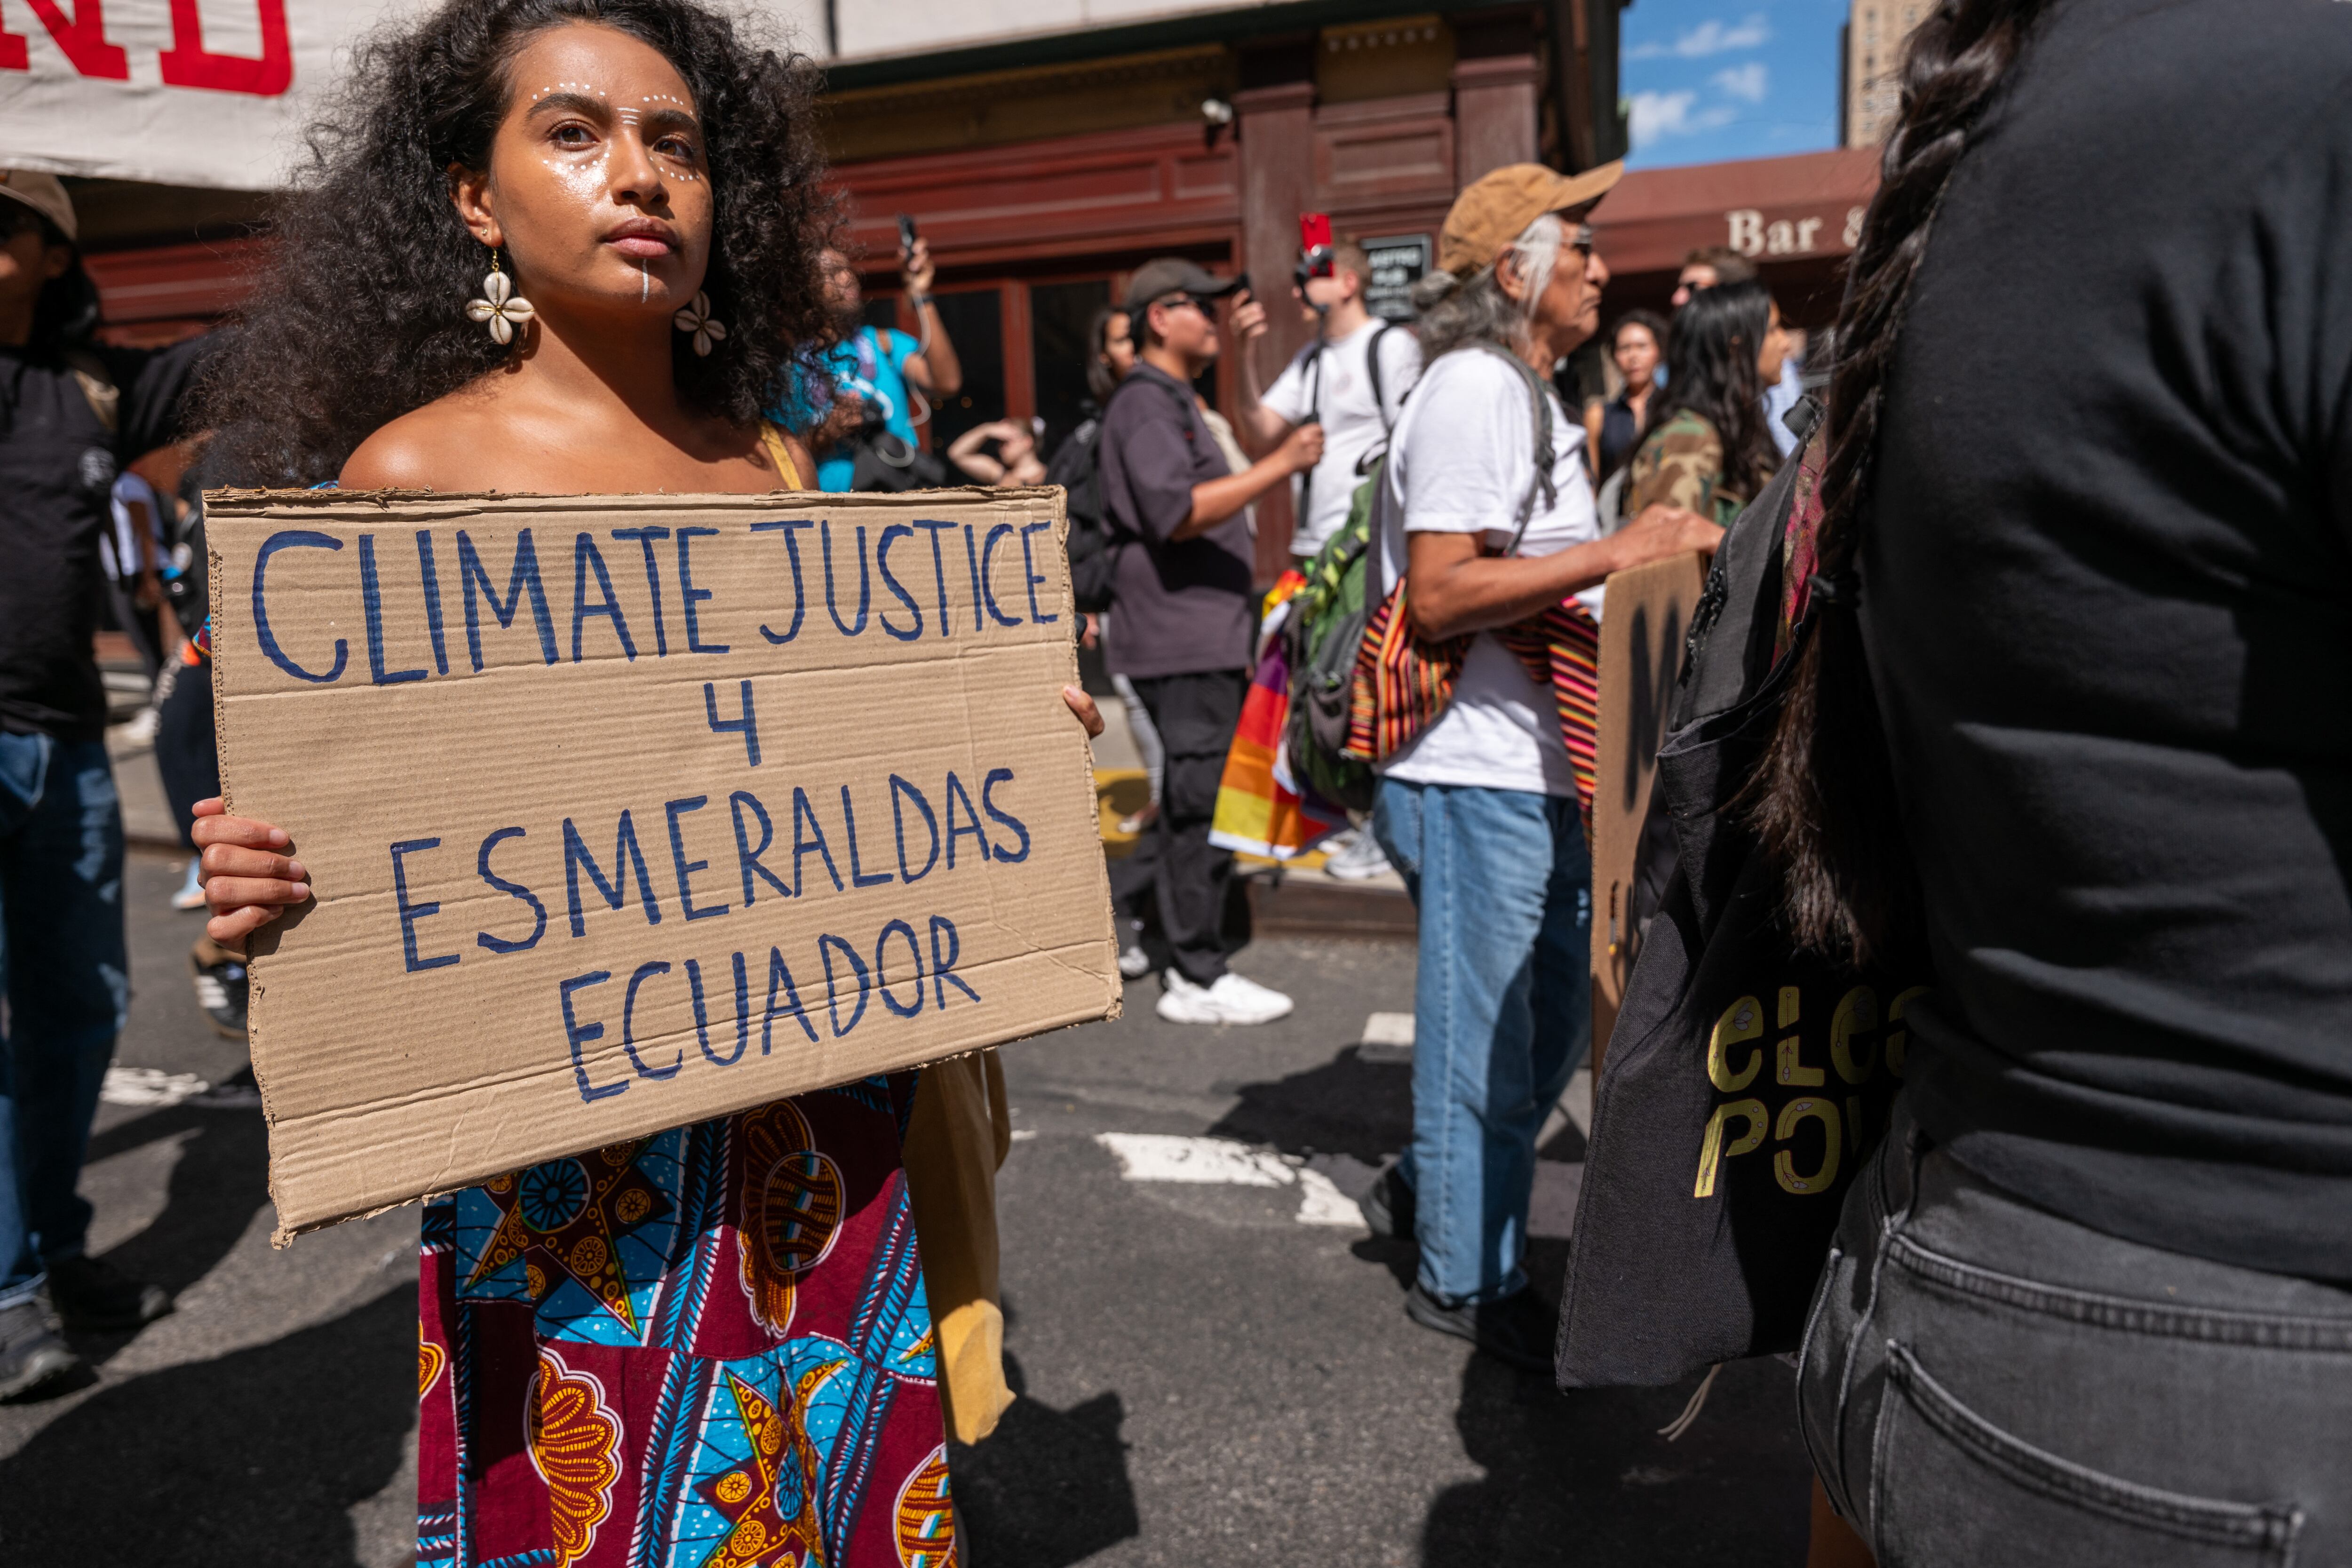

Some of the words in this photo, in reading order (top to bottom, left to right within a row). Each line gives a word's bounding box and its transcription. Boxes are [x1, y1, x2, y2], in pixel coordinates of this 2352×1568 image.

[1724, 209, 1823, 257] Bar
[252, 525, 731, 685] CLIMATE
[750, 519, 1058, 645] JUSTICE
[704, 680, 761, 766] 4
[390, 768, 1030, 972] ESMERALDAS
[560, 915, 980, 1104] ECUADOR
